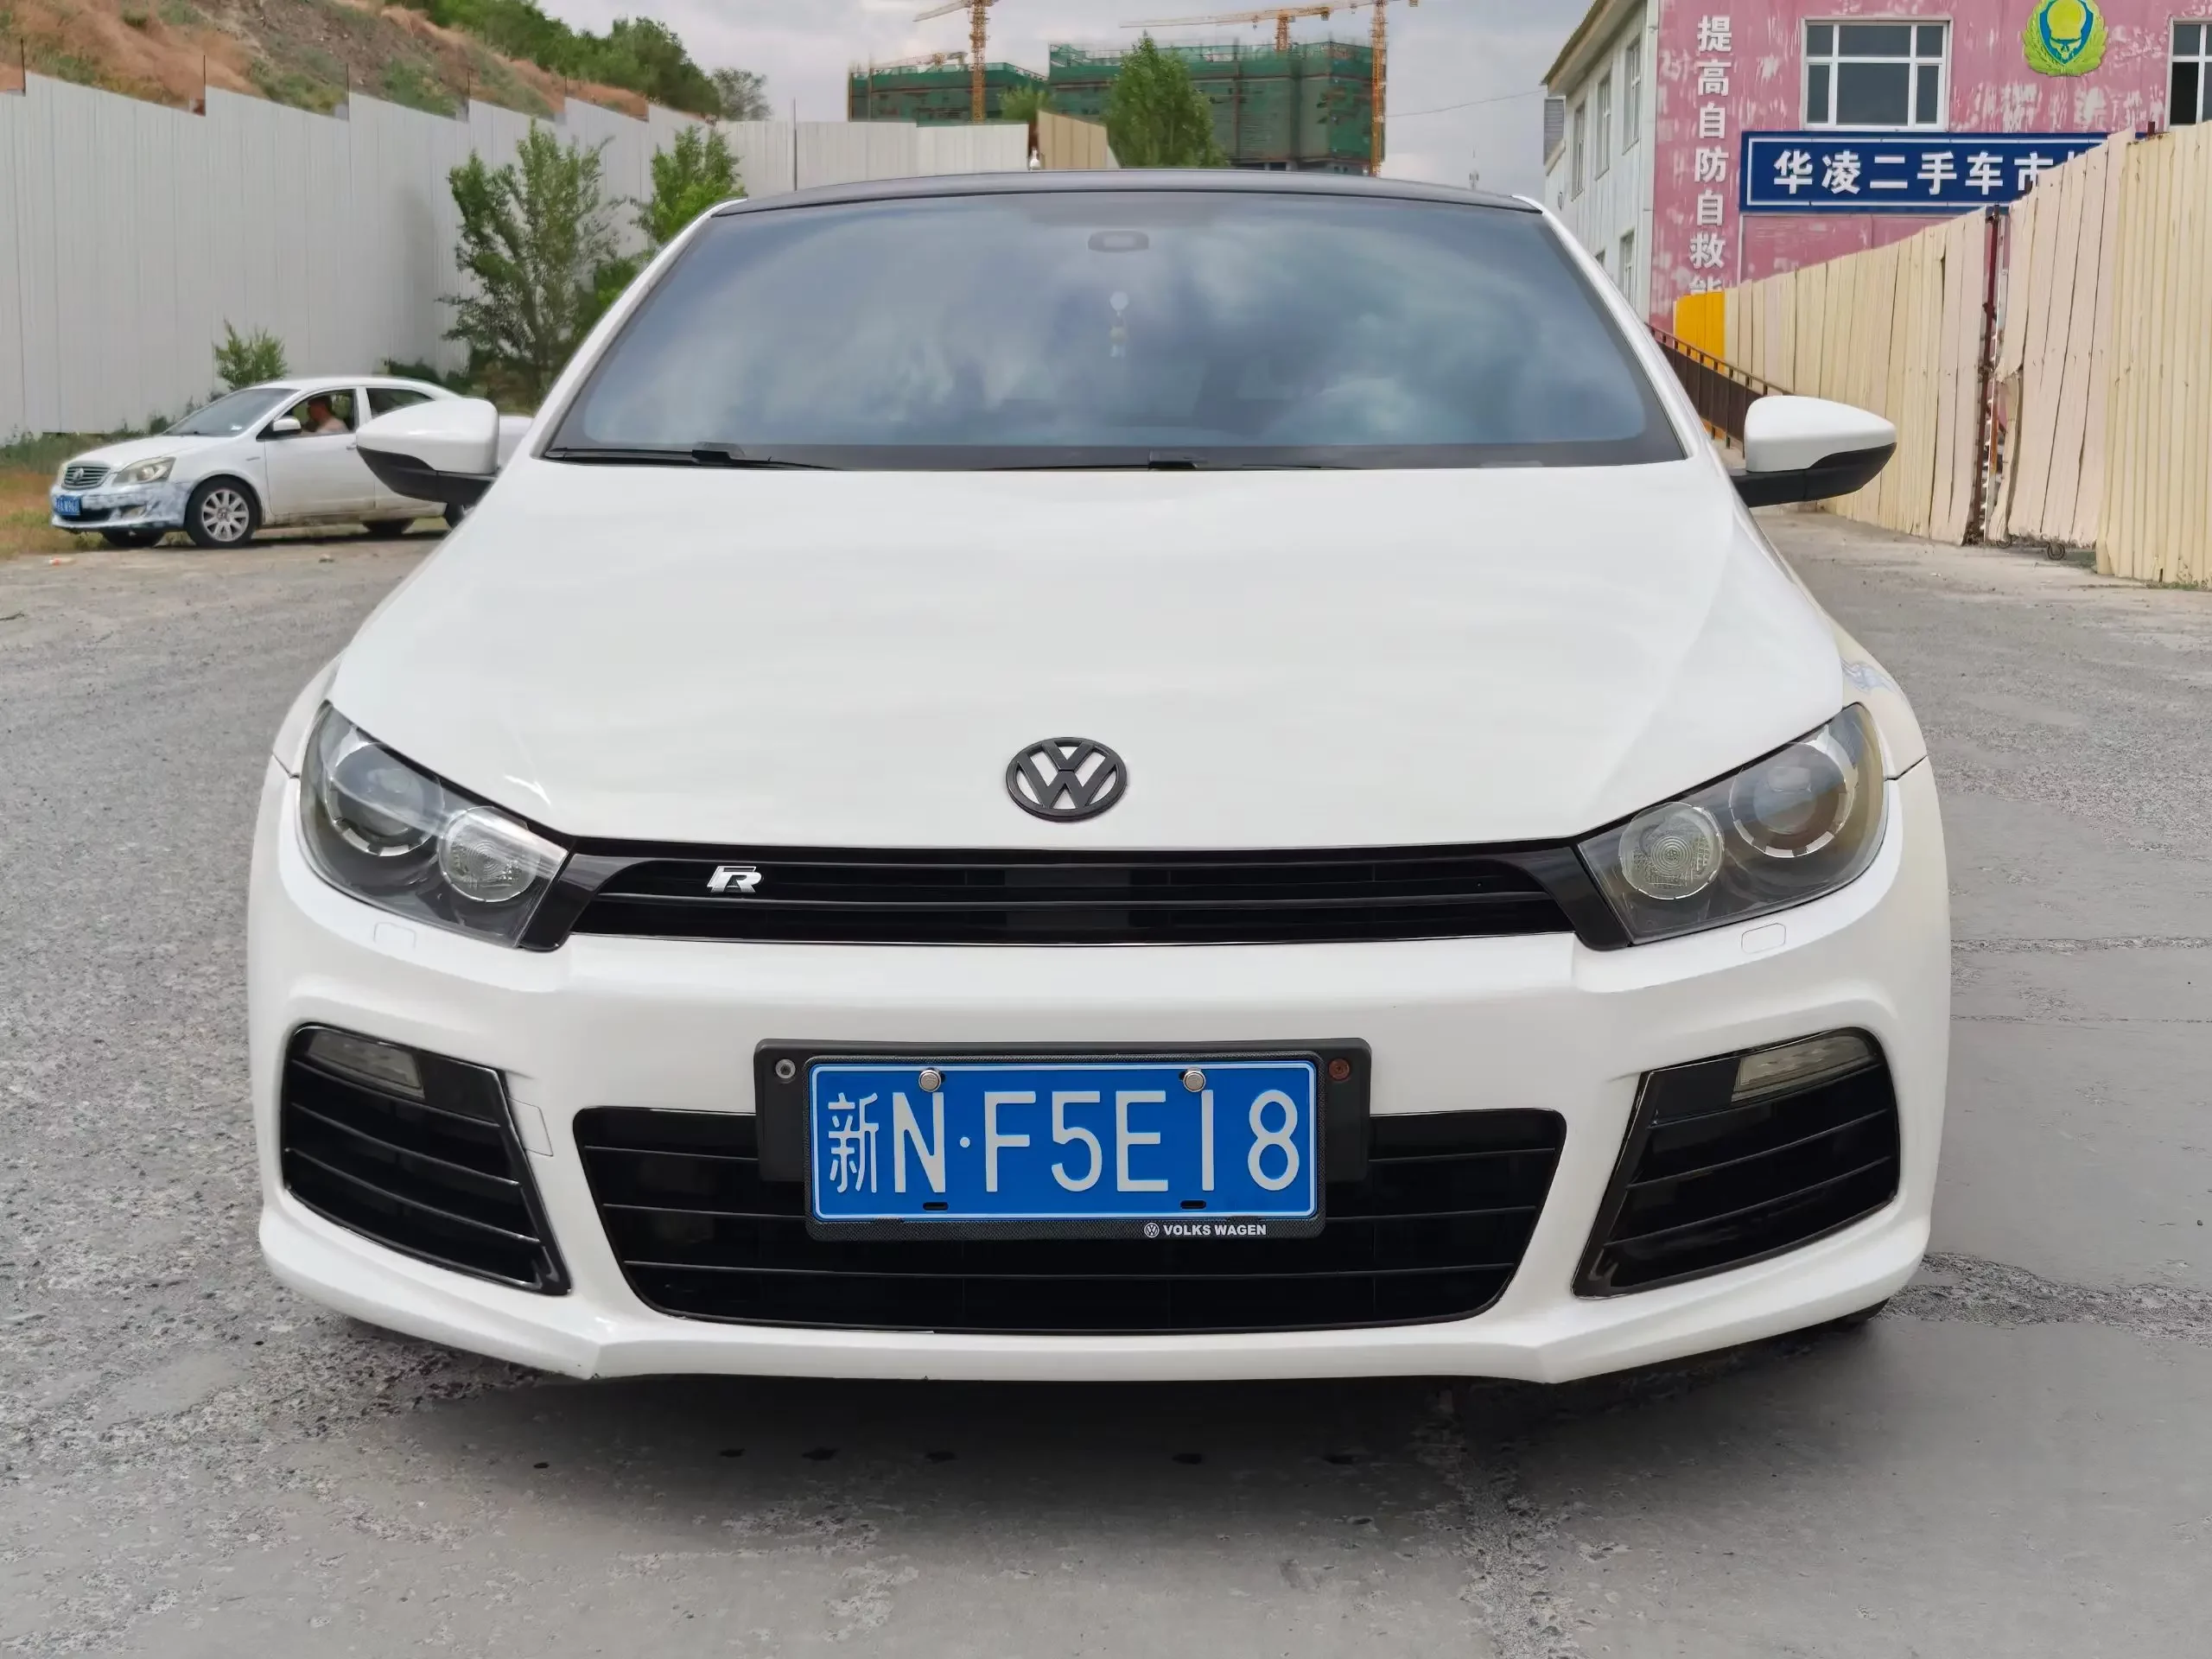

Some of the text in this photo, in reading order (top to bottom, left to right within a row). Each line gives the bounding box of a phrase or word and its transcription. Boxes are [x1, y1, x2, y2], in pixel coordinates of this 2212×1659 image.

[1774, 150, 2075, 196] 华凌二手车市
[707, 866, 762, 893] R
[1163, 1224, 1211, 1236] VOLKS
[1214, 1224, 1267, 1236] WAGEN
